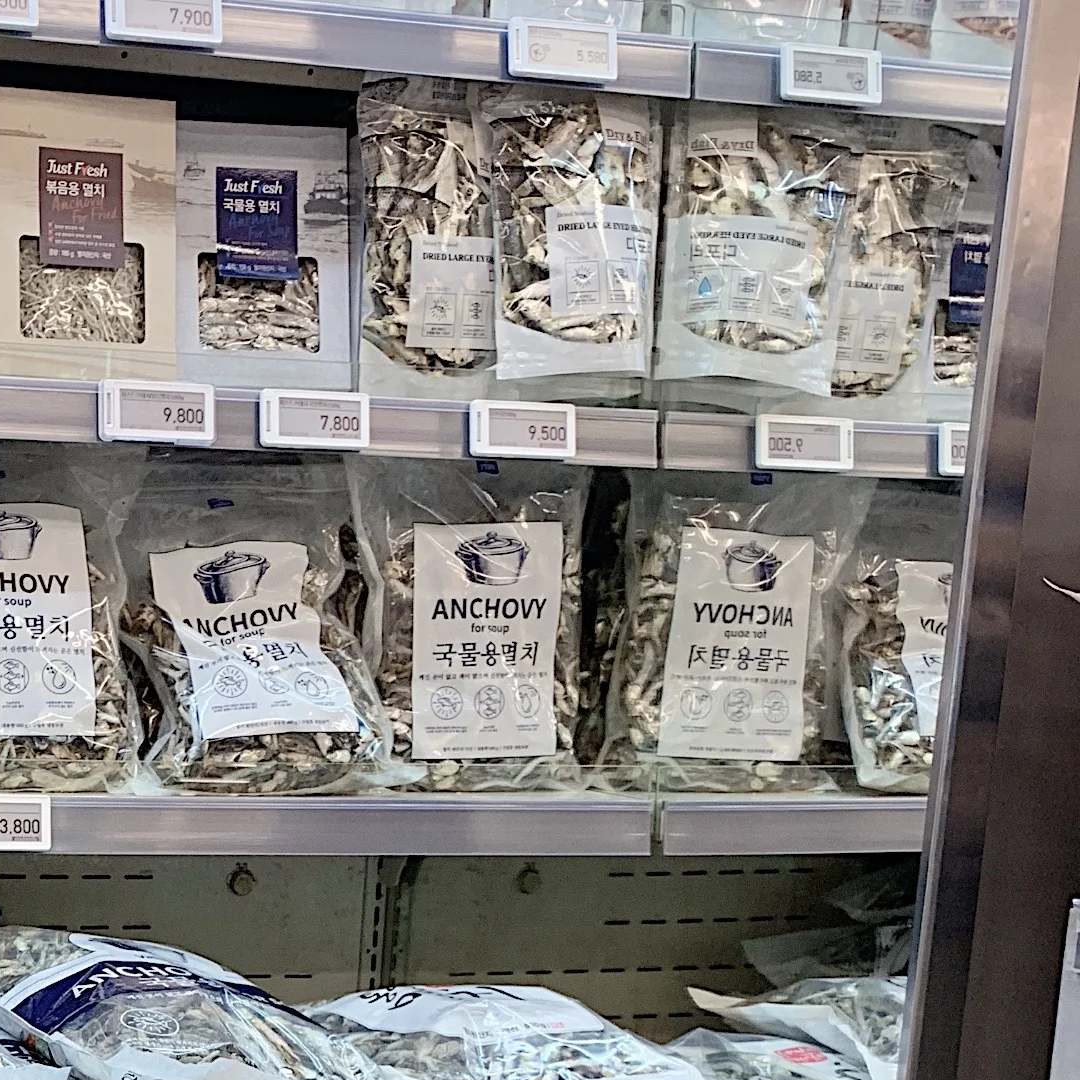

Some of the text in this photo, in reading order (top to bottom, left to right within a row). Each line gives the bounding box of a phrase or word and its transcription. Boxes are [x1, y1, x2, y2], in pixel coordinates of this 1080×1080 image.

[170, 8, 212, 26] 7,900
[607, 128, 624, 142] Dry
[46, 159, 108, 178] Just Fresh
[46, 180, 106, 198] 볶음용 멸치
[223, 178, 283, 194] Just Fresh
[223, 198, 280, 214] 국물용 멸치
[558, 222, 586, 231] DRIED
[587, 221, 612, 230] LAGE
[423, 252, 447, 261] DRIED
[448, 253, 474, 262] LARGE
[163, 407, 204, 424] 9,800
[320, 415, 360, 431] 7,800
[528, 425, 567, 441] 9,500
[4, 598, 32, 608] soup
[432, 598, 547, 620] ANCHOVY
[471, 623, 510, 635] for soup
[220, 628, 265, 647] for soup
[432, 641, 539, 667] 국물용멸치
[71, 963, 194, 998] ANCHO
